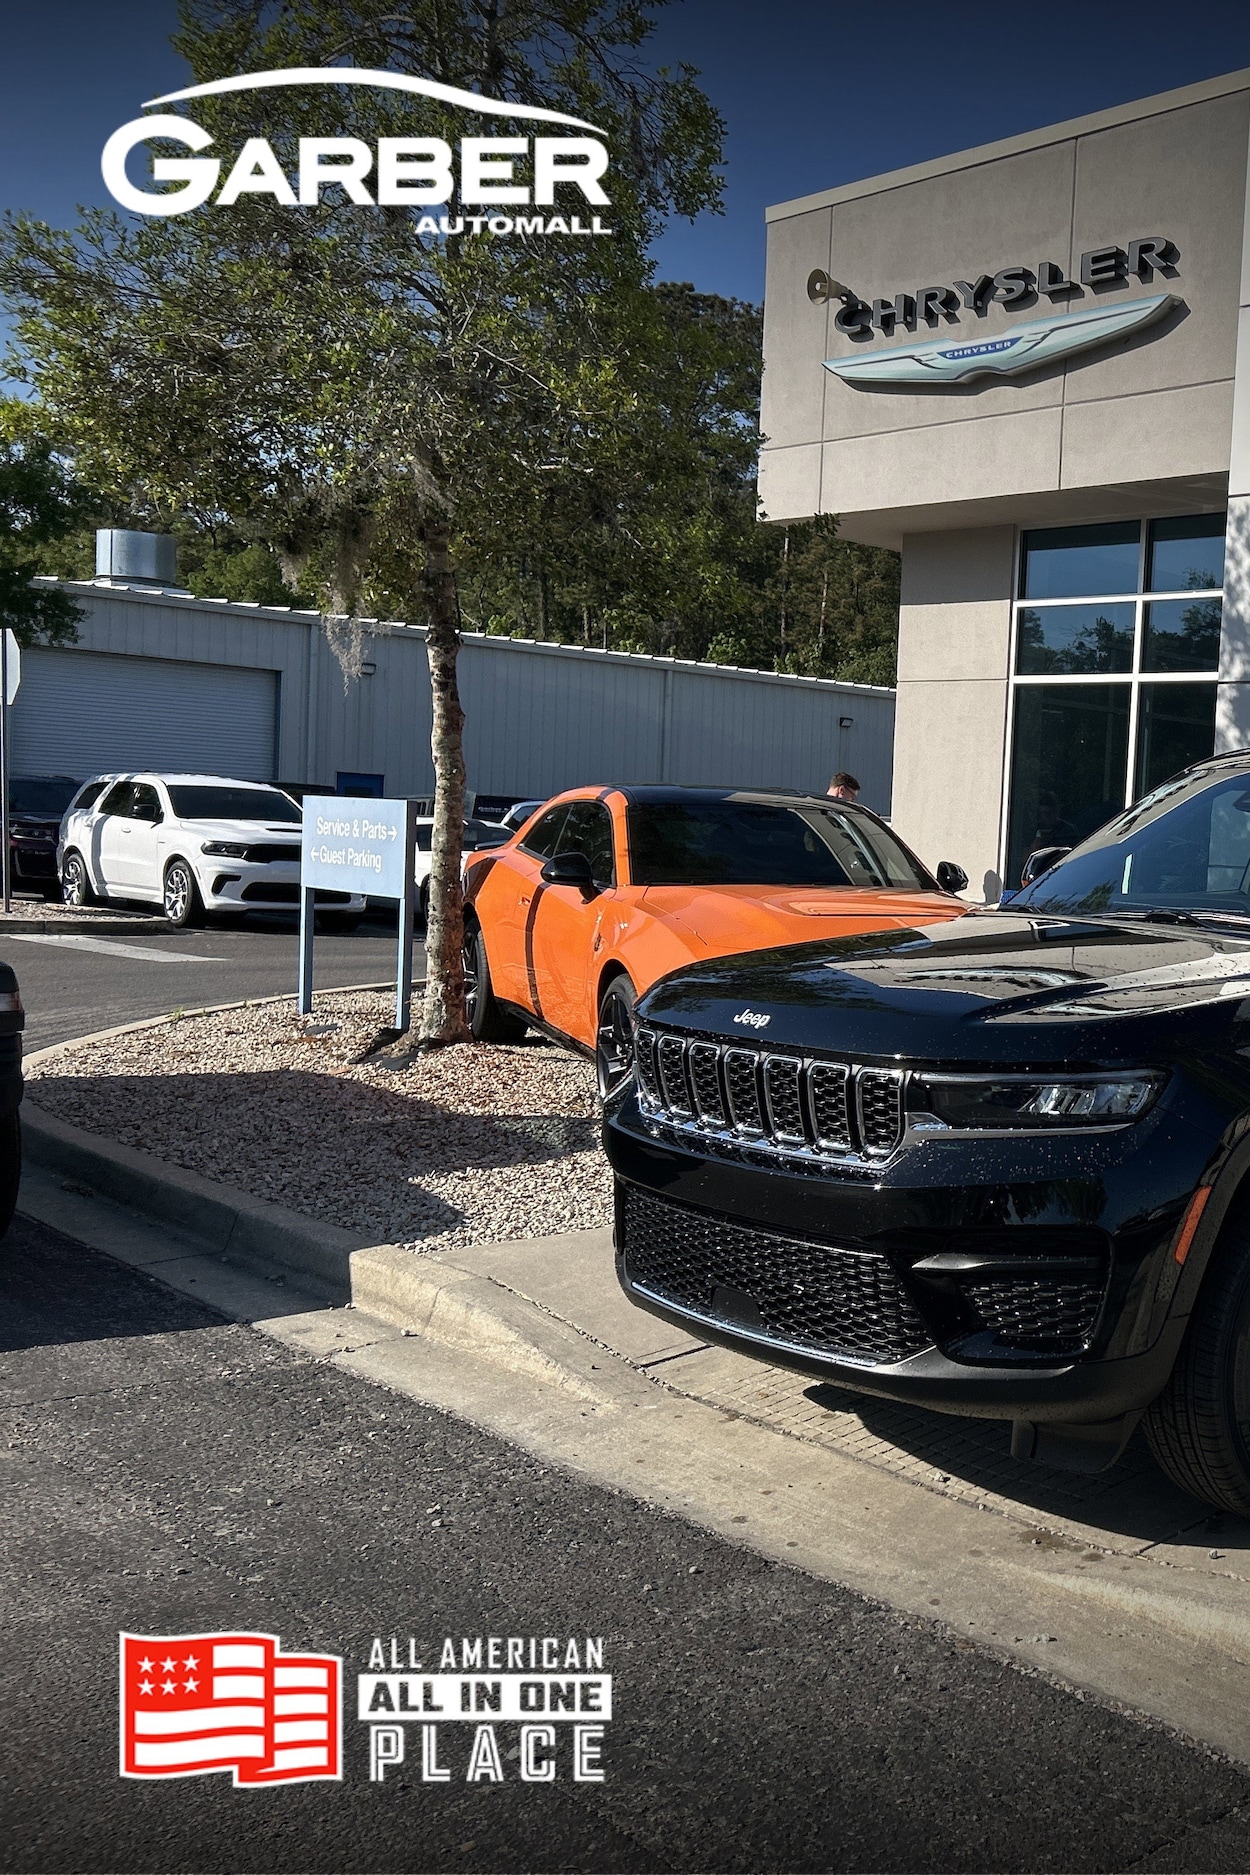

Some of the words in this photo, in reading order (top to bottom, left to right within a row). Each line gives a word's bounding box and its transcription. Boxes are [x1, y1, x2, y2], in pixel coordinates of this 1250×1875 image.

[835, 236, 1180, 341] CHRYSLER
[945, 339, 1012, 359] CHRYSLER
[316, 815, 350, 837] Service
[352, 821, 360, 838] &
[361, 821, 388, 840] Parts
[319, 847, 347, 865] Guest
[347, 849, 382, 874] Parking
[733, 1008, 771, 1029] Jeep
